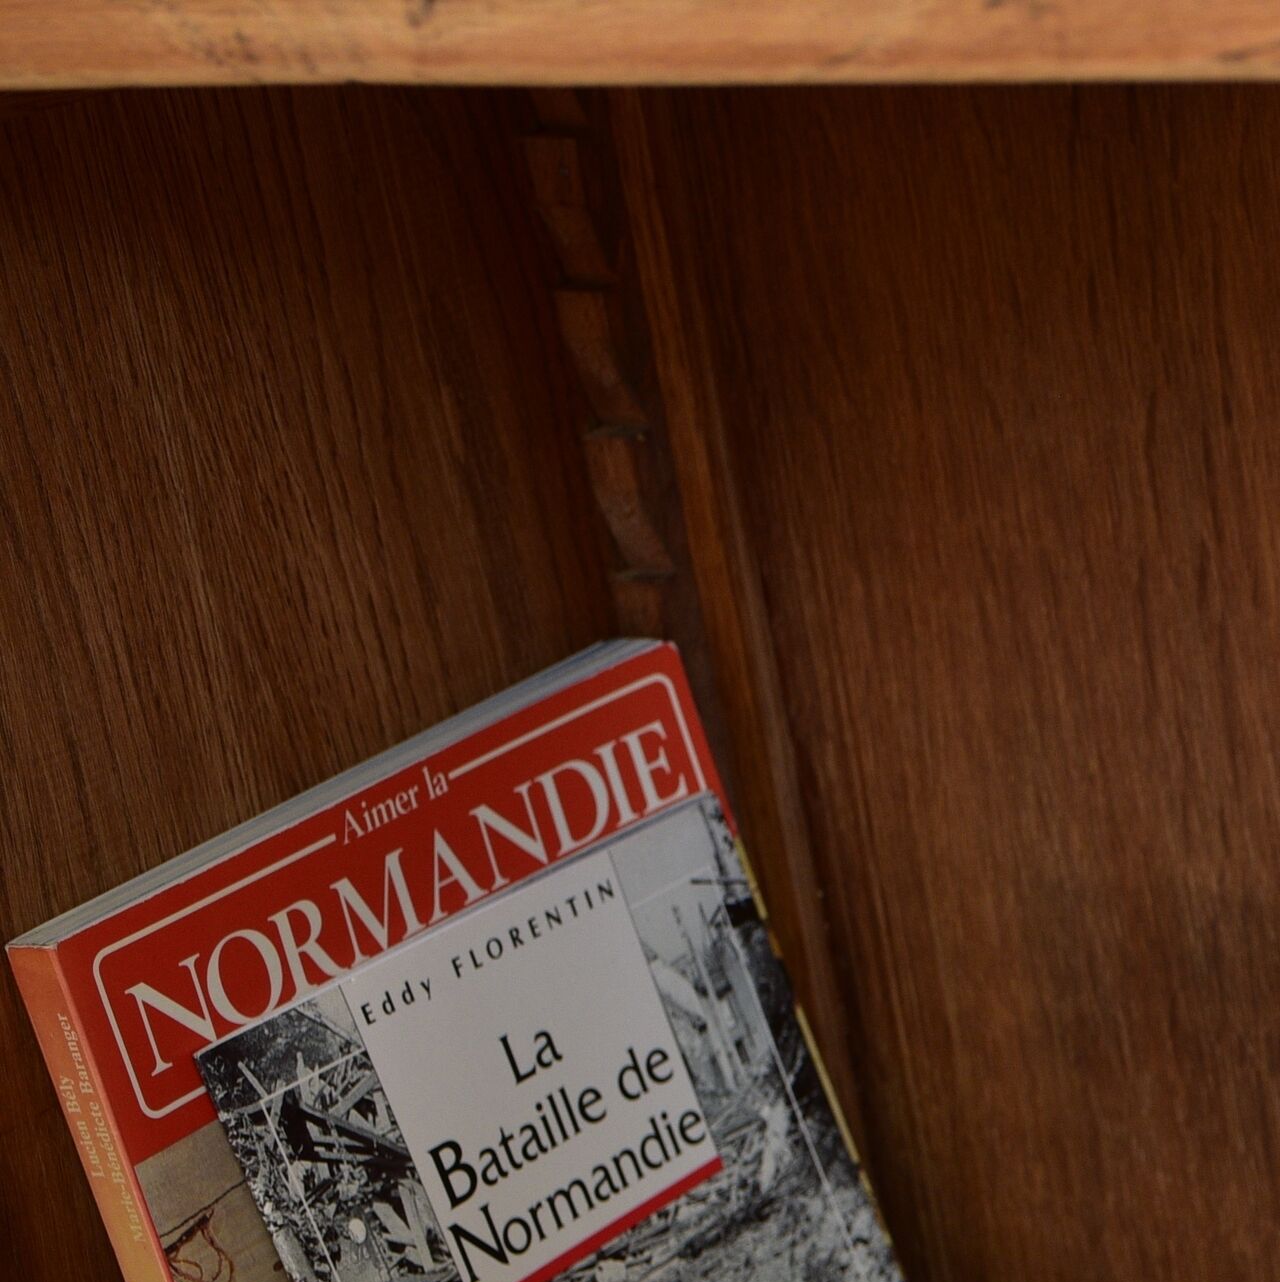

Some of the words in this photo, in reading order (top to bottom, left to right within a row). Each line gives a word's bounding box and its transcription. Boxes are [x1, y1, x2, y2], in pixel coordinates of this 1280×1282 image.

[341, 786, 420, 846] Aimer
[425, 766, 450, 802] la
[125, 721, 688, 1077] NORMANDIE
[361, 978, 433, 1025] Eddy
[451, 879, 616, 978] FLORENTIN
[57, 1012, 94, 1095] Baranger
[500, 1029, 563, 1085] La
[59, 1075, 81, 1114] Bély
[428, 1086, 608, 1210] Bataille
[617, 1045, 674, 1101] de
[77, 1120, 103, 1179] Lucien
